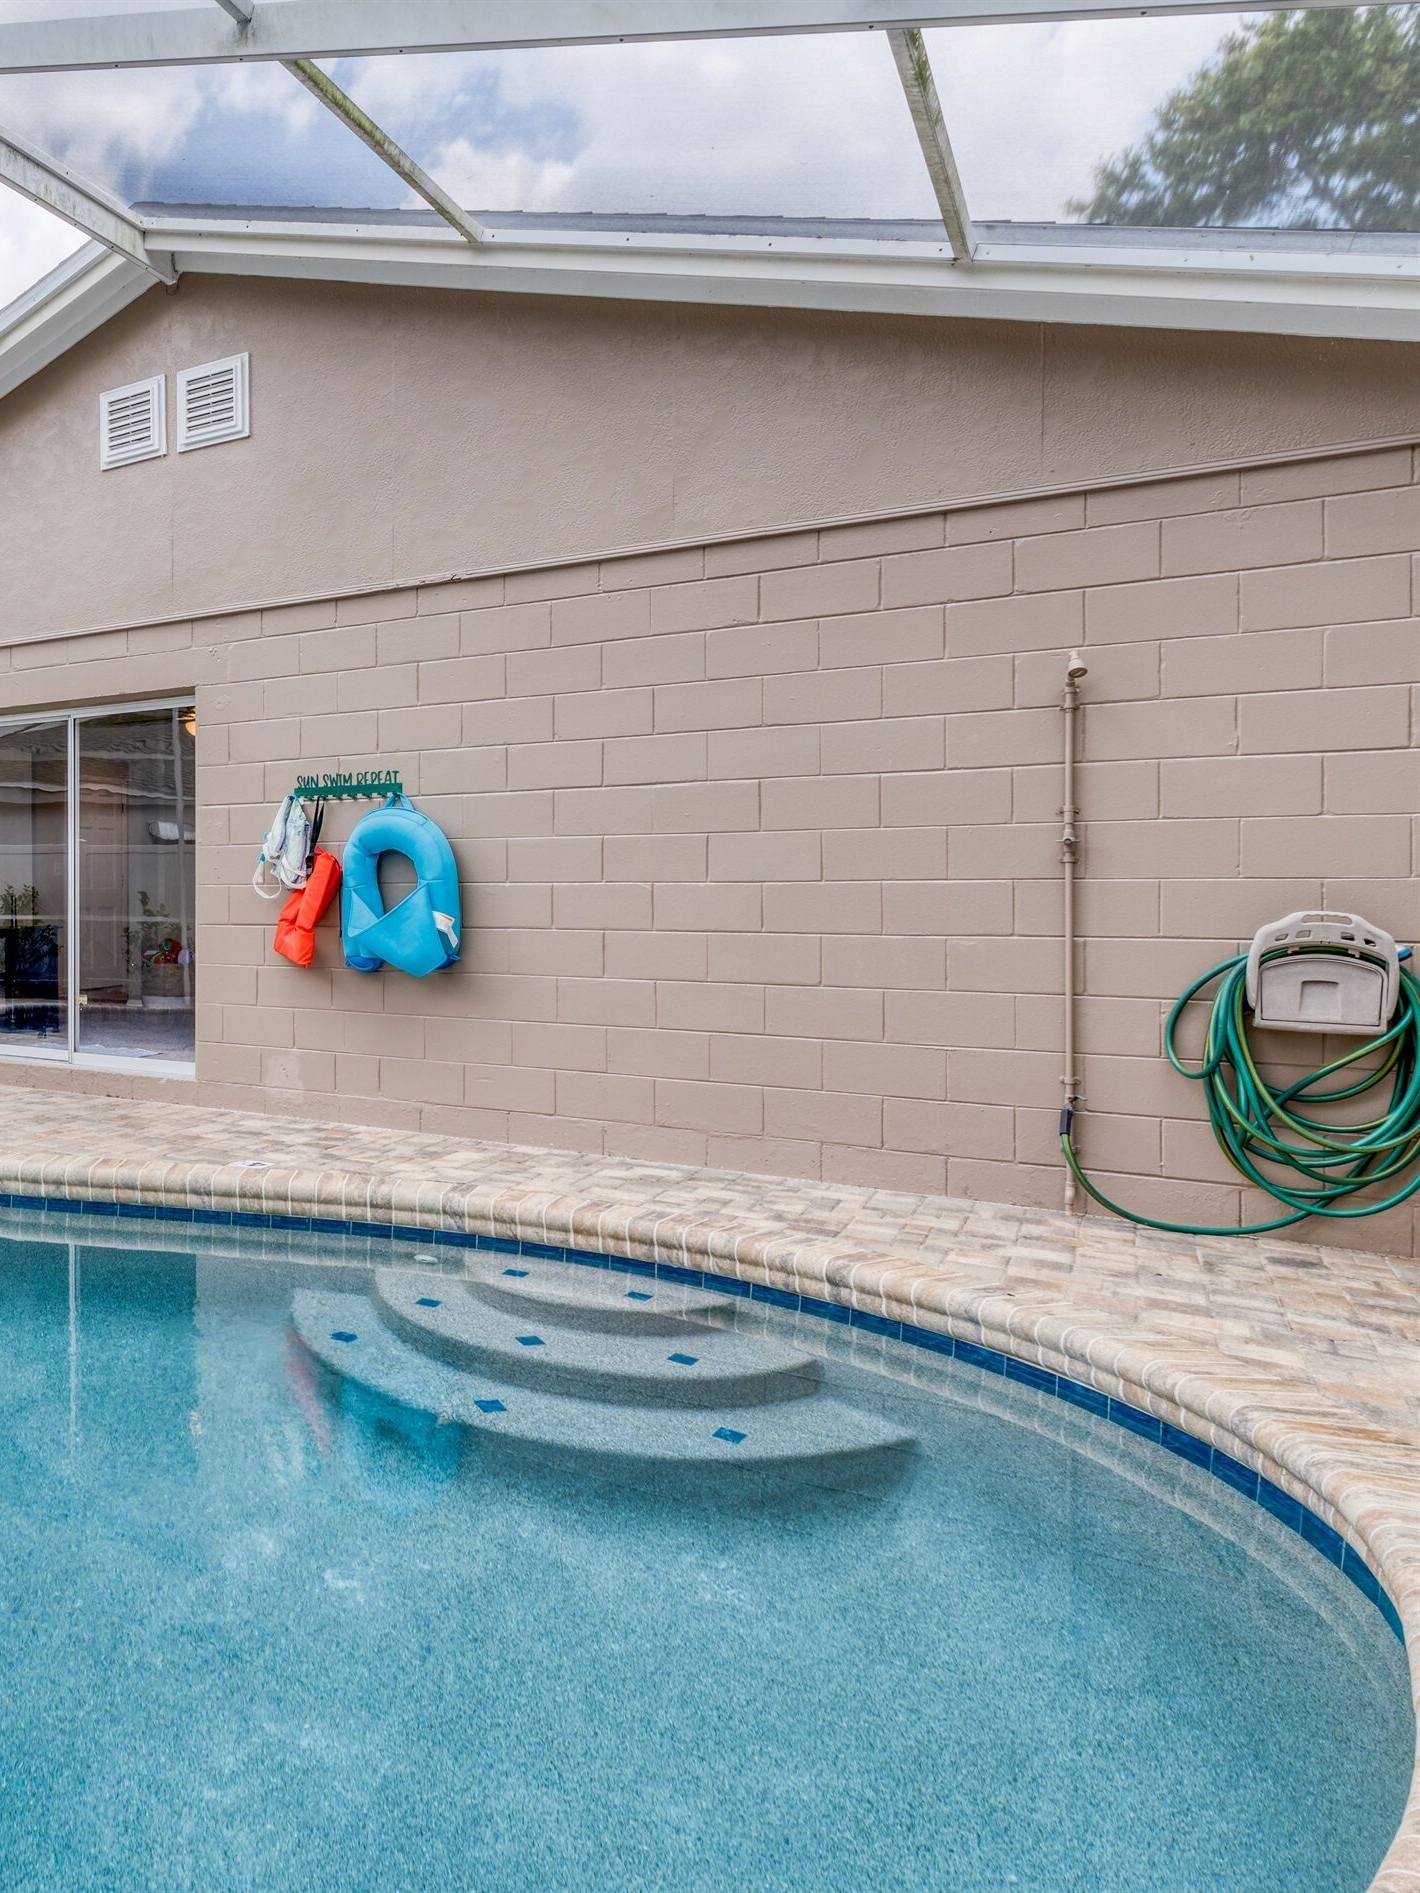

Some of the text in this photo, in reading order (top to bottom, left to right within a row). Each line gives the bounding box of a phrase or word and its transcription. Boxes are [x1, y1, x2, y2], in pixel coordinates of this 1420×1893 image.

[297, 771, 399, 788] SUN SWIM REPEAT
